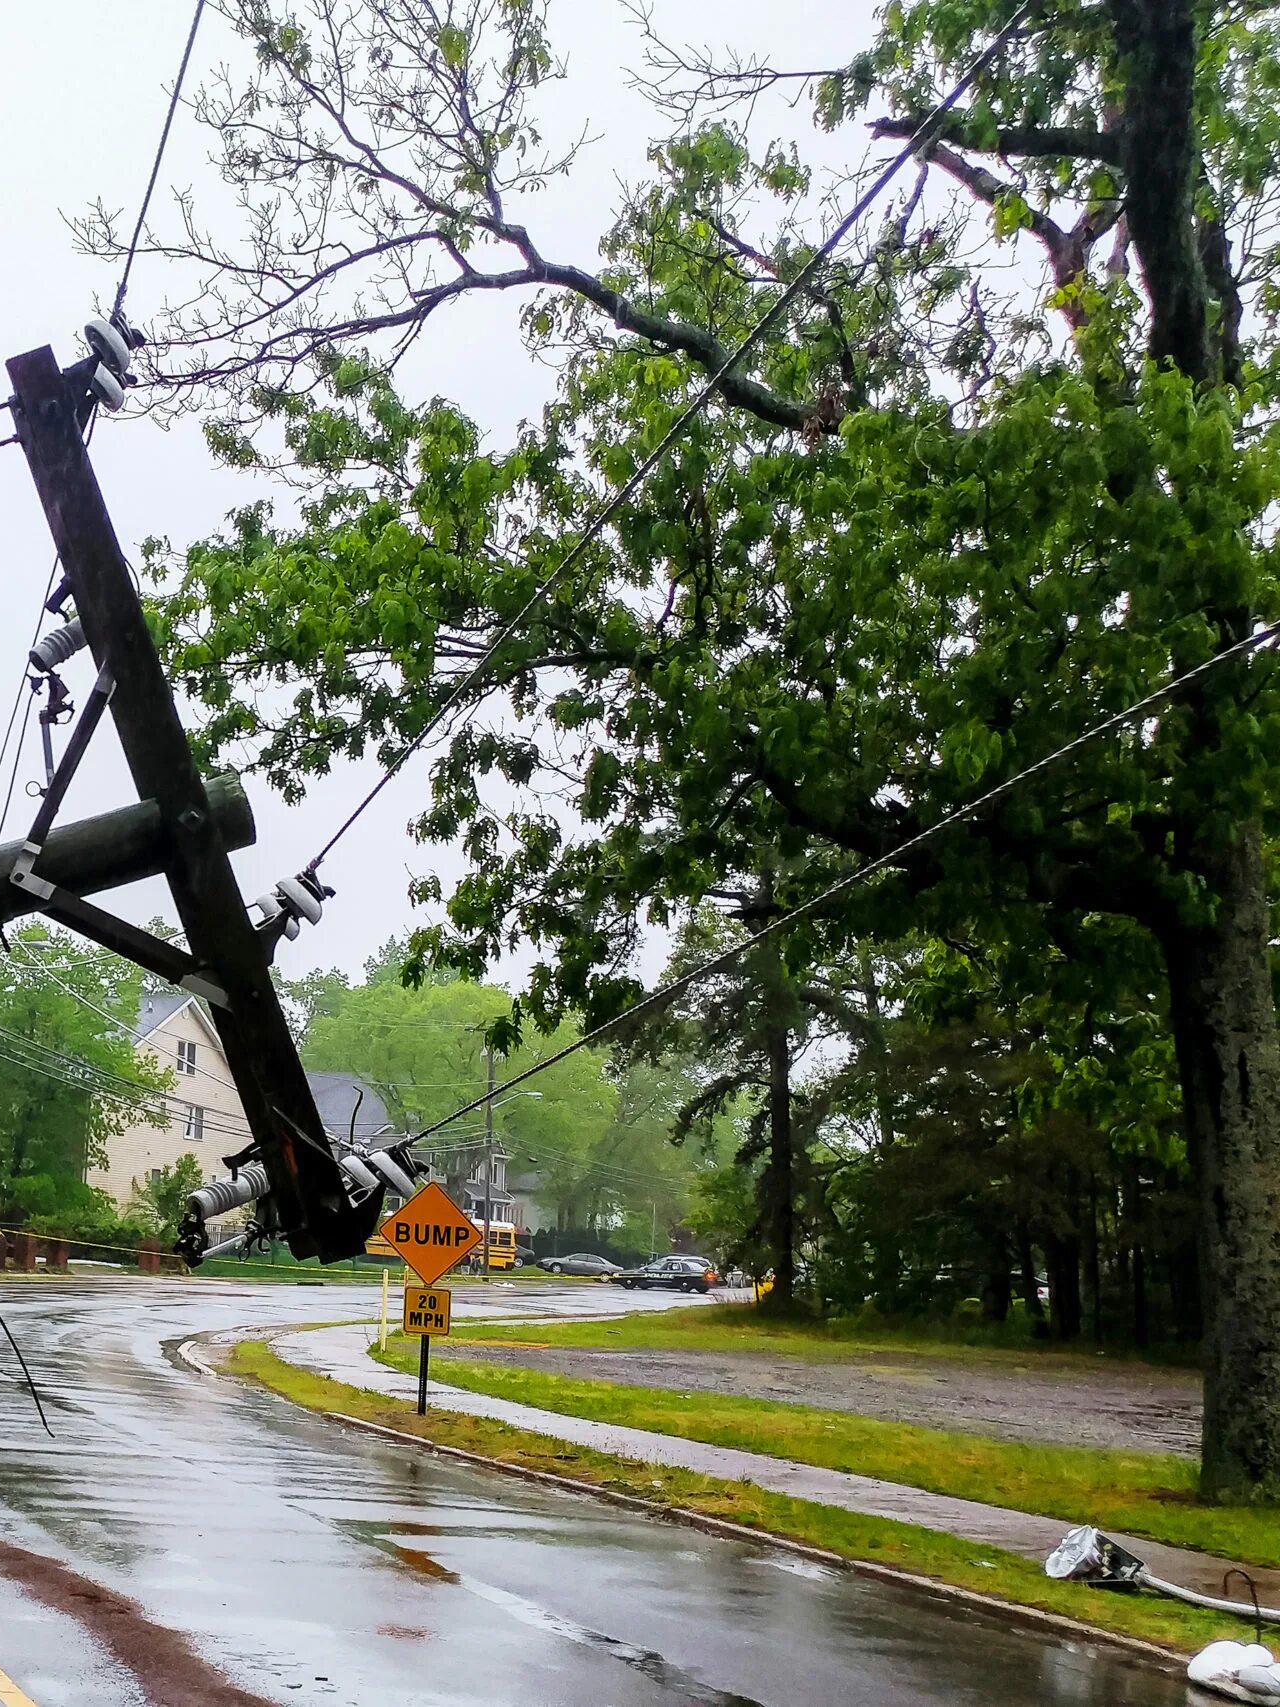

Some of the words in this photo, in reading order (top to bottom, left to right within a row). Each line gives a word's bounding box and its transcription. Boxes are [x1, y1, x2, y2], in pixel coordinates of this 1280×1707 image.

[395, 1222, 470, 1247] BUMP
[418, 1295, 437, 1309] 20
[409, 1311, 444, 1328] MPH
